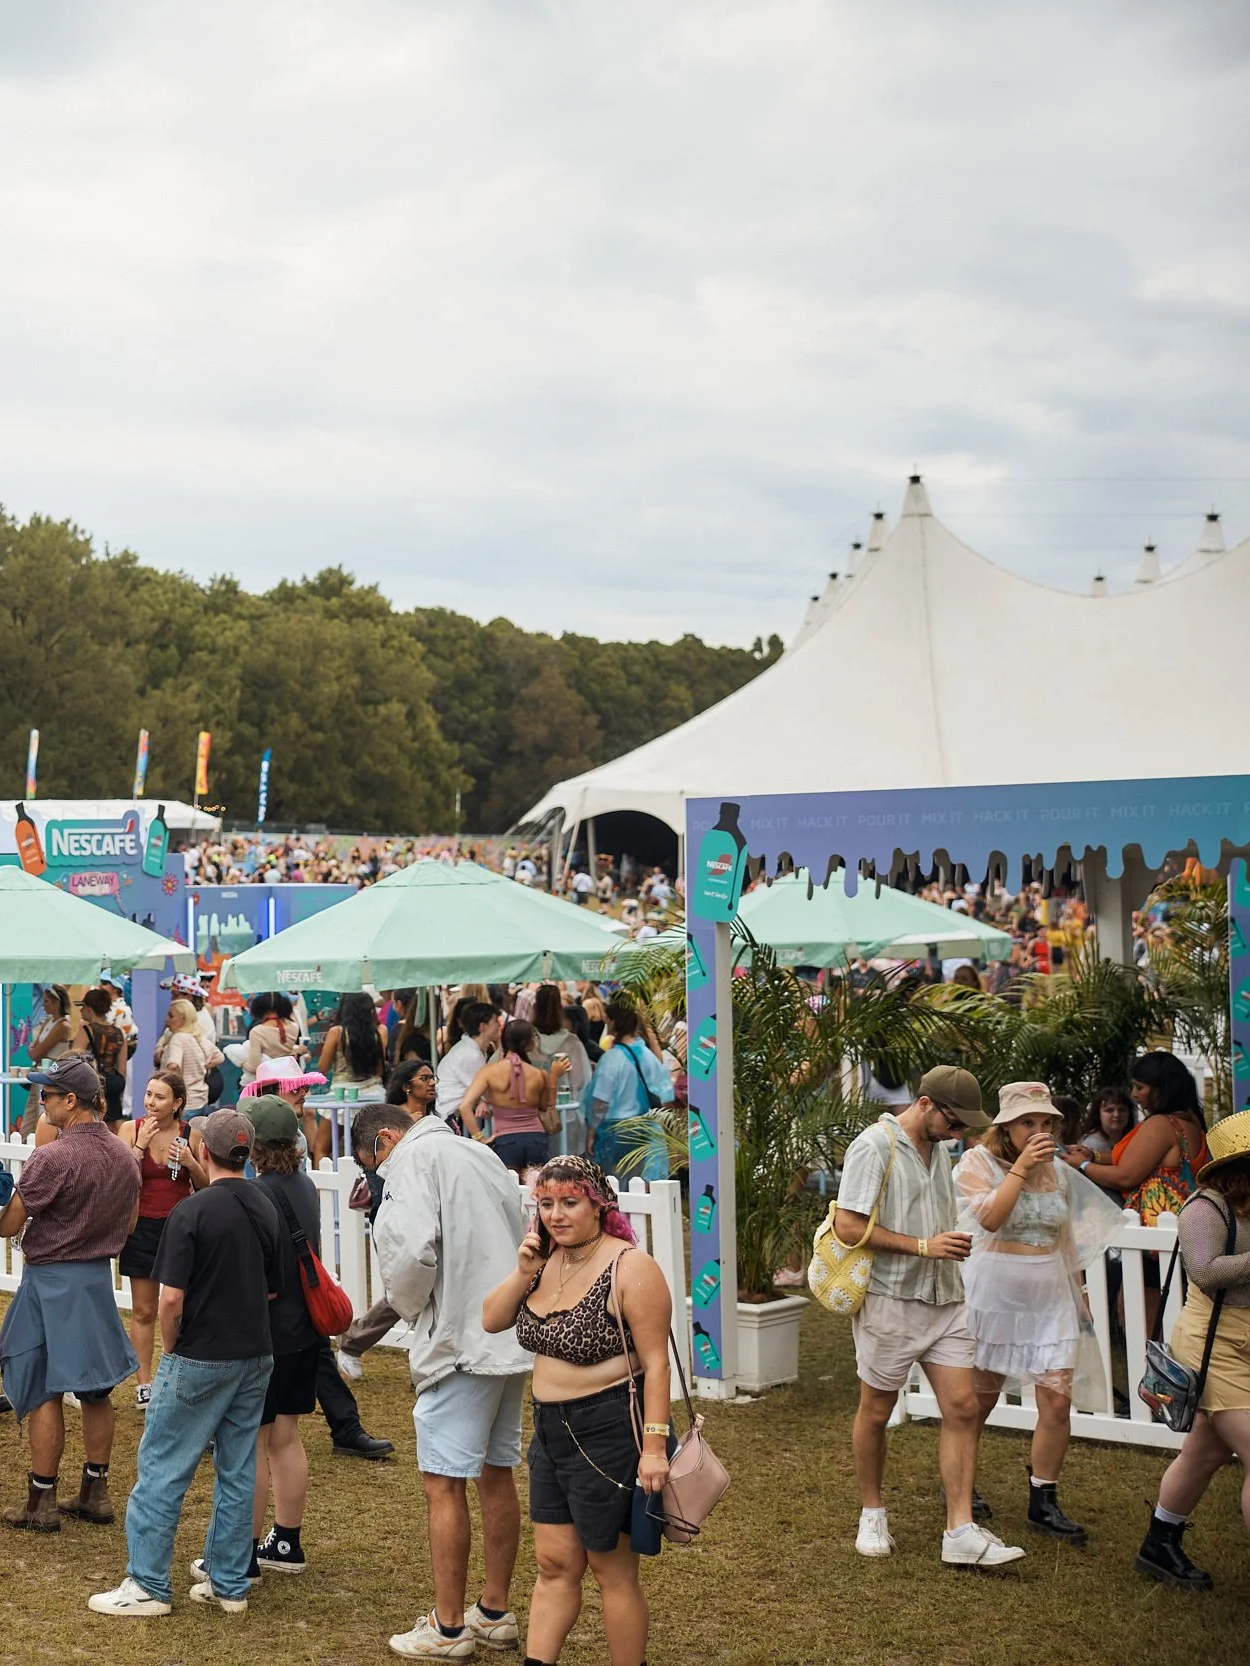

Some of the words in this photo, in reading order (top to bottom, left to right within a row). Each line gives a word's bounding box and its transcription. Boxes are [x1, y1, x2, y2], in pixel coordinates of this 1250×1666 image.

[751, 818, 773, 830] MIX
[776, 817, 789, 829] IT
[798, 816, 832, 828] HACK
[836, 815, 849, 827] IT
[858, 814, 896, 826] POUR
[899, 813, 911, 825] IT
[921, 813, 945, 824] MIX
[950, 812, 963, 823] IT
[973, 811, 1012, 823] HACK
[1016, 810, 1029, 822] IT
[1040, 808, 1082, 821] POUR
[1086, 807, 1099, 819] IT
[1110, 806, 1139, 819] MIX
[1143, 805, 1156, 817] IT
[1169, 804, 1212, 816] HACK
[1216, 803, 1232, 815] IT
[72, 876, 114, 887] LANEWAY
